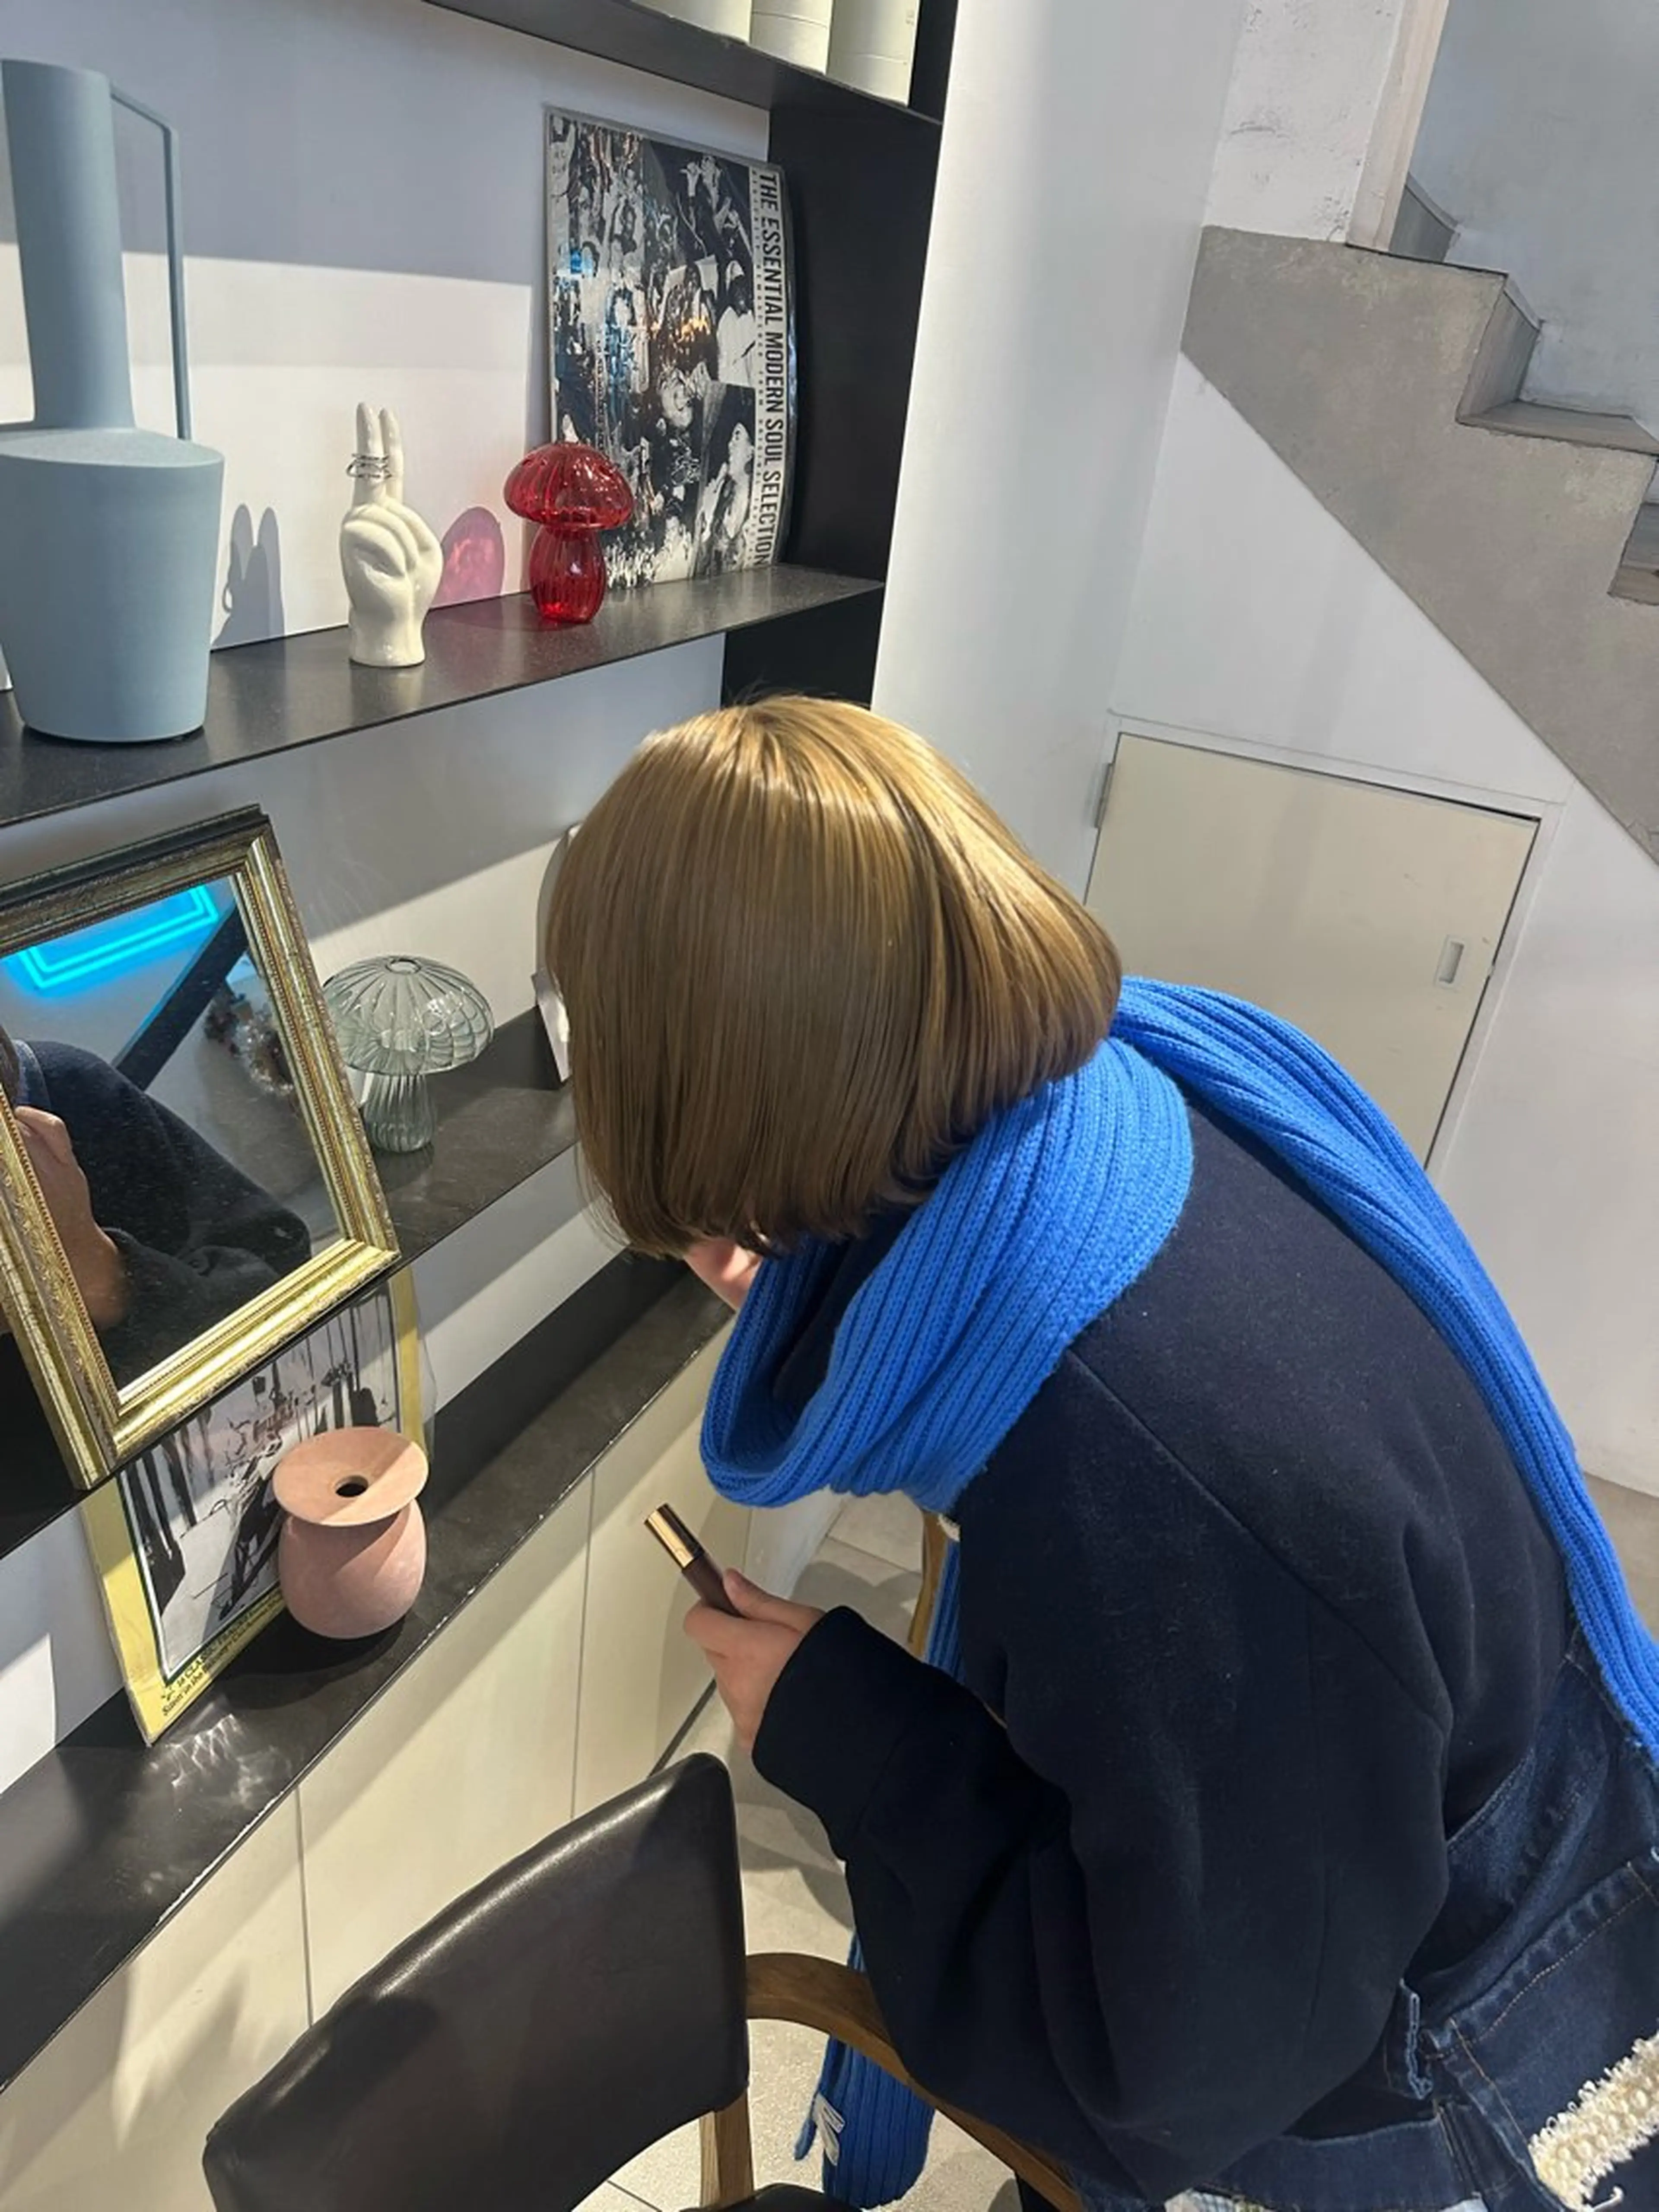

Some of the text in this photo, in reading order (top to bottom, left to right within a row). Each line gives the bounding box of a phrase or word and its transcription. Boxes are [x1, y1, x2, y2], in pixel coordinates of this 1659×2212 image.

[760, 175, 778, 211] THE
[761, 217, 783, 325] ESSENTIAL
[765, 332, 784, 412] MODERN
[764, 419, 783, 466] SOUL
[753, 471, 781, 566] SELECTION
